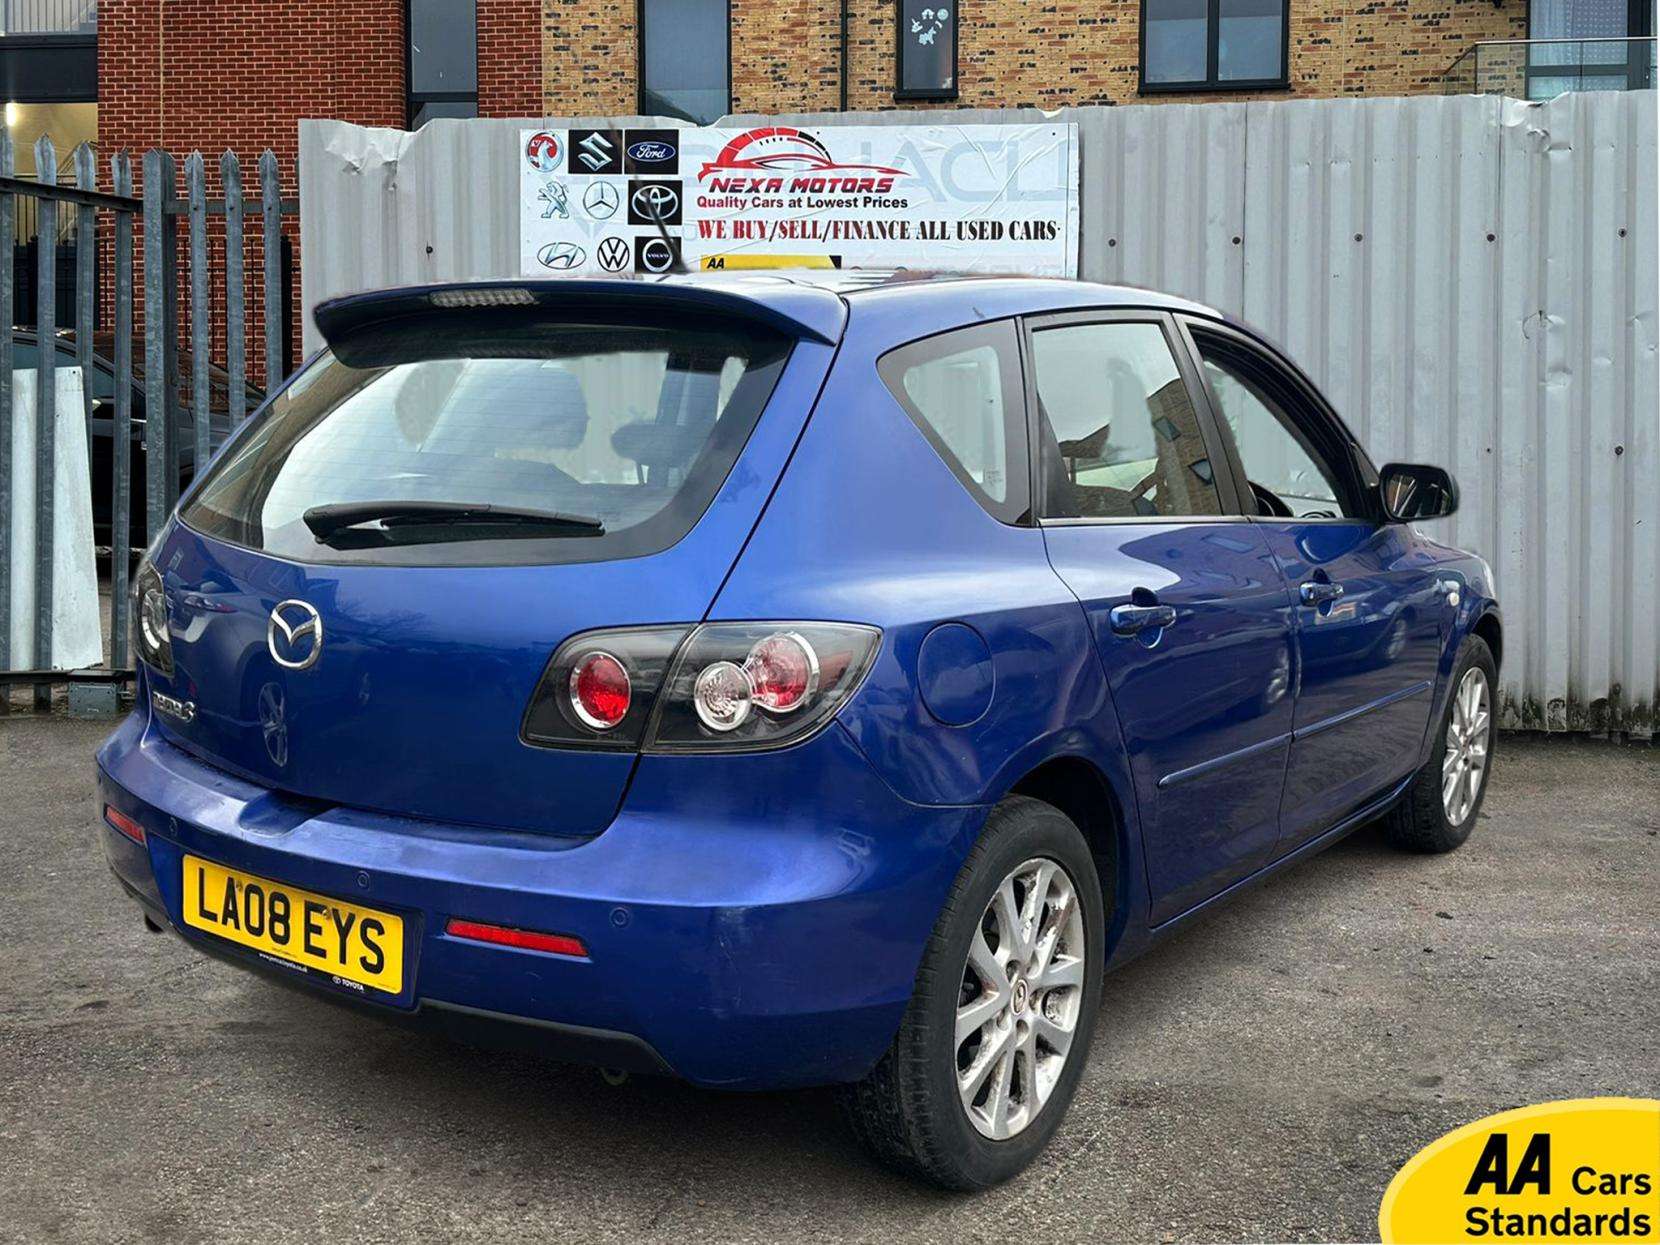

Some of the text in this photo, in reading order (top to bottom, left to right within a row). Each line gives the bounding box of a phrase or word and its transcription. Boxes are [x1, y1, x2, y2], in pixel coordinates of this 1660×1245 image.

[636, 143, 666, 158] Ford
[708, 177, 894, 193] NEXA MOTORS
[696, 196, 908, 210] Quality Cars at Lowest Prices
[697, 219, 726, 239] WE
[915, 221, 950, 240] ALL
[956, 220, 1004, 240] USED
[1008, 220, 1057, 240] CARS
[706, 257, 725, 269] AA
[199, 866, 386, 975] LA08 EYS
[342, 979, 365, 991] TOYOTA
